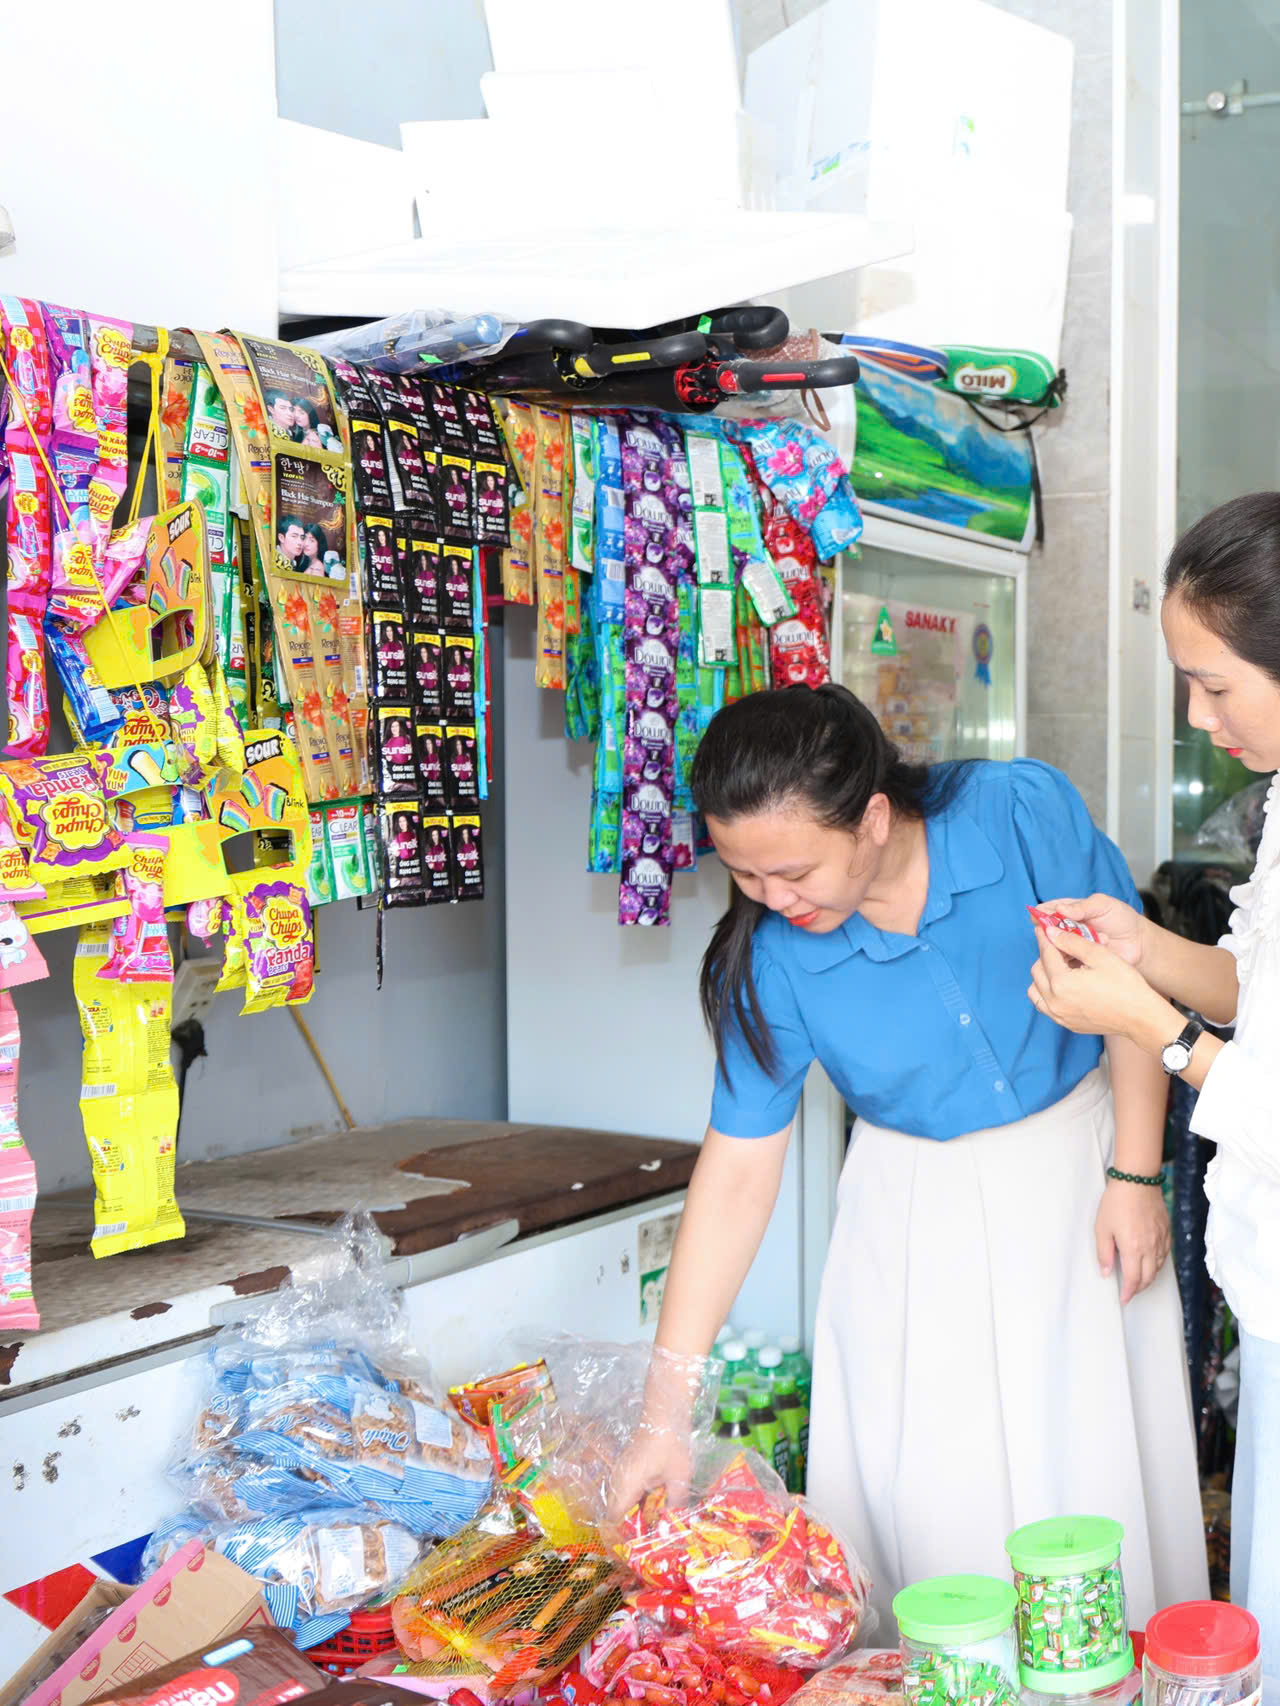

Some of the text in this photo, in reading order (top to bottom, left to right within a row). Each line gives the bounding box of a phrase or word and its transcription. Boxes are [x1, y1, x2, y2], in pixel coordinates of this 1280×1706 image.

[960, 374, 1007, 390] MILO
[193, 426, 228, 450] CLEAR
[633, 574, 674, 602] Downy
[905, 610, 958, 634] SANAKY
[634, 647, 674, 674] Downy
[246, 738, 280, 765] SOUR
[31, 772, 98, 797] Panda
[106, 779, 124, 790] YUM
[107, 767, 129, 780] YUM
[52, 797, 101, 819] Chups
[631, 793, 670, 818] Downy
[56, 816, 105, 835] Chupa
[330, 821, 359, 834] CLEAR
[629, 867, 668, 891] Downy
[268, 905, 299, 923] Chupa
[270, 918, 303, 941] Chups
[265, 943, 311, 966] Panda
